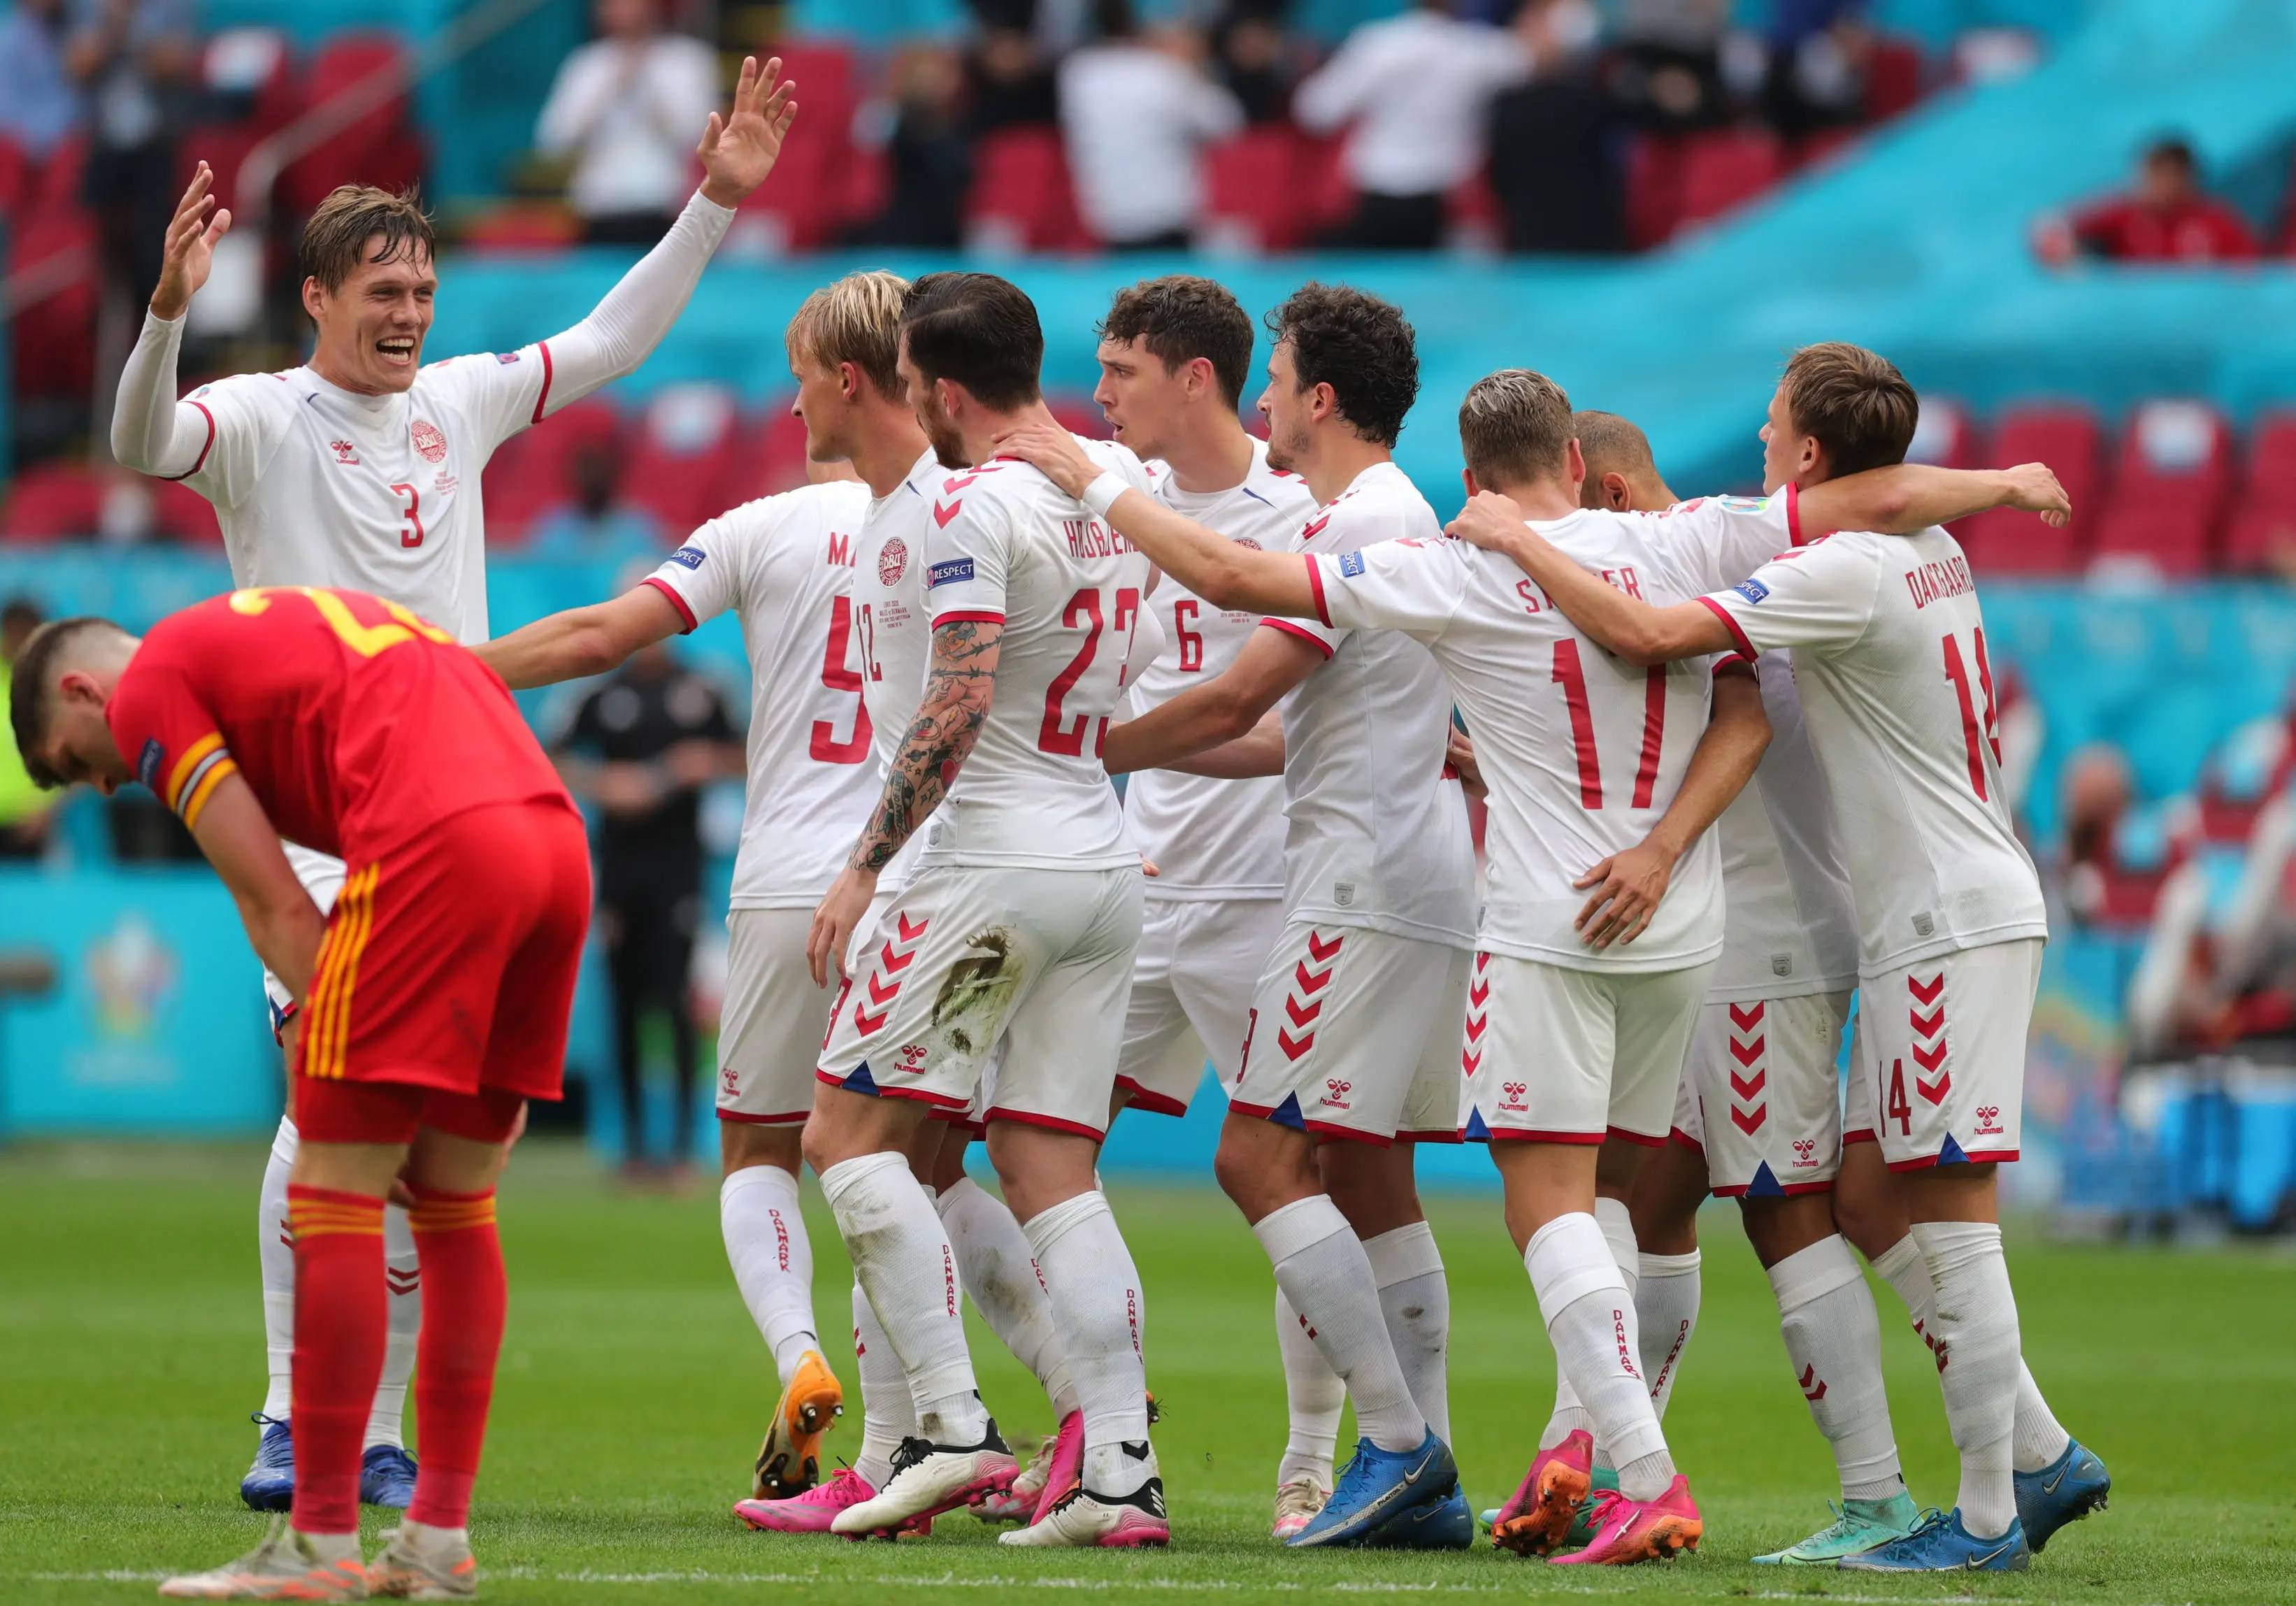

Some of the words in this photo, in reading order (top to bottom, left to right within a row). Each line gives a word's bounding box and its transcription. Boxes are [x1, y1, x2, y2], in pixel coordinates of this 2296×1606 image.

[390, 483, 424, 547] 3
[884, 553, 901, 571] DBU
[934, 564, 973, 580] RESPECT
[856, 603, 883, 682] 12
[1175, 600, 1203, 672] 6
[810, 596, 874, 764] 5
[1942, 626, 2002, 803] 14
[894, 1062, 926, 1075] hummel
[1879, 1058, 1911, 1138] 14
[1319, 1096, 1350, 1110] hummel
[1498, 1101, 1528, 1112] hummel
[1974, 1126, 2004, 1135] hummel
[1792, 1159, 1818, 1168] hummel
[768, 1209, 791, 1273] DANMARK
[942, 1245, 957, 1317] DANMARK
[1651, 1319, 1689, 1398] DANMARK
